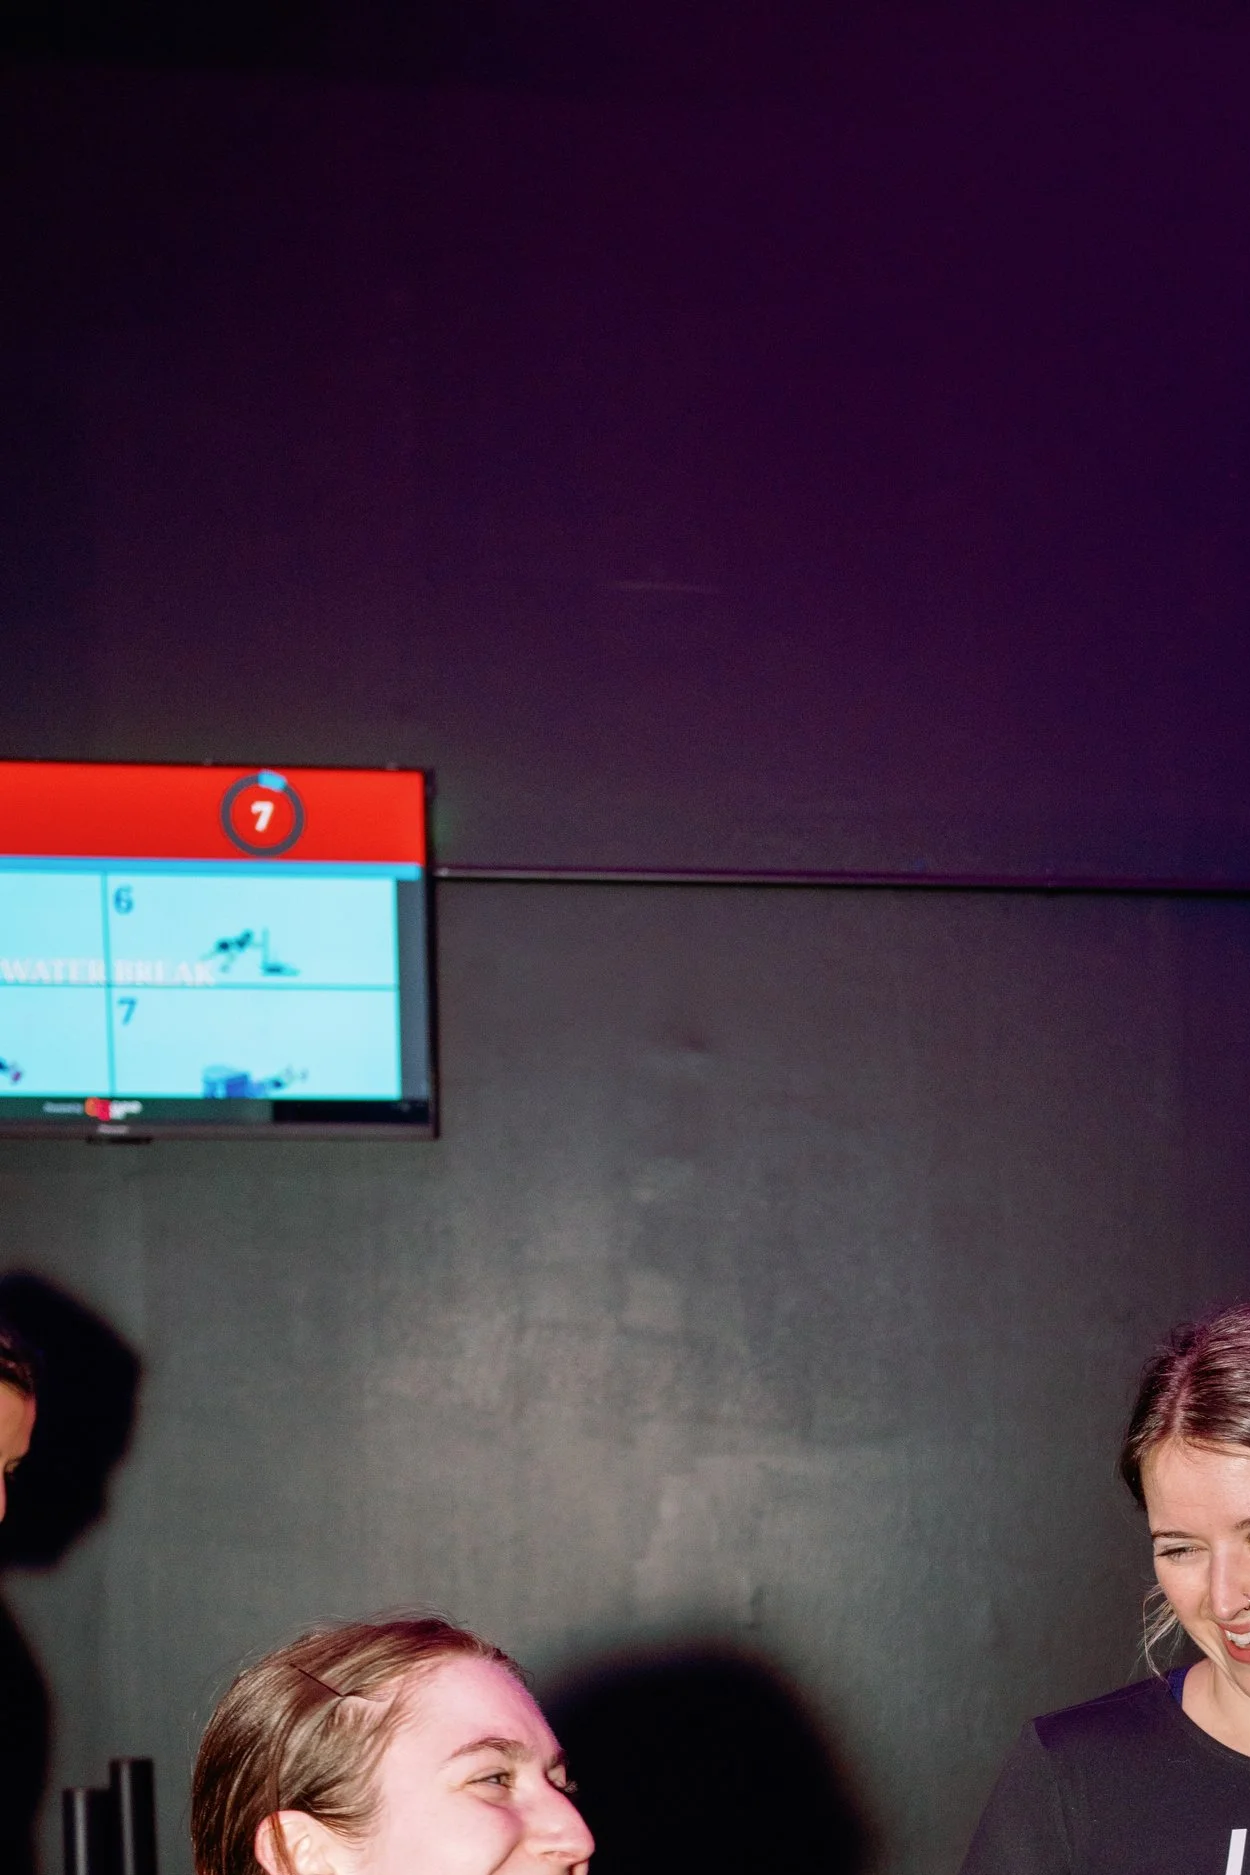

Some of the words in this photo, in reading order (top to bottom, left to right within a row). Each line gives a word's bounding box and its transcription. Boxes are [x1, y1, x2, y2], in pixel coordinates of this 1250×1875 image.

[251, 800, 275, 832] 7
[113, 885, 134, 915] 6
[0, 957, 106, 985] WATER
[114, 958, 217, 986] BREAK
[117, 996, 138, 1025] 7
